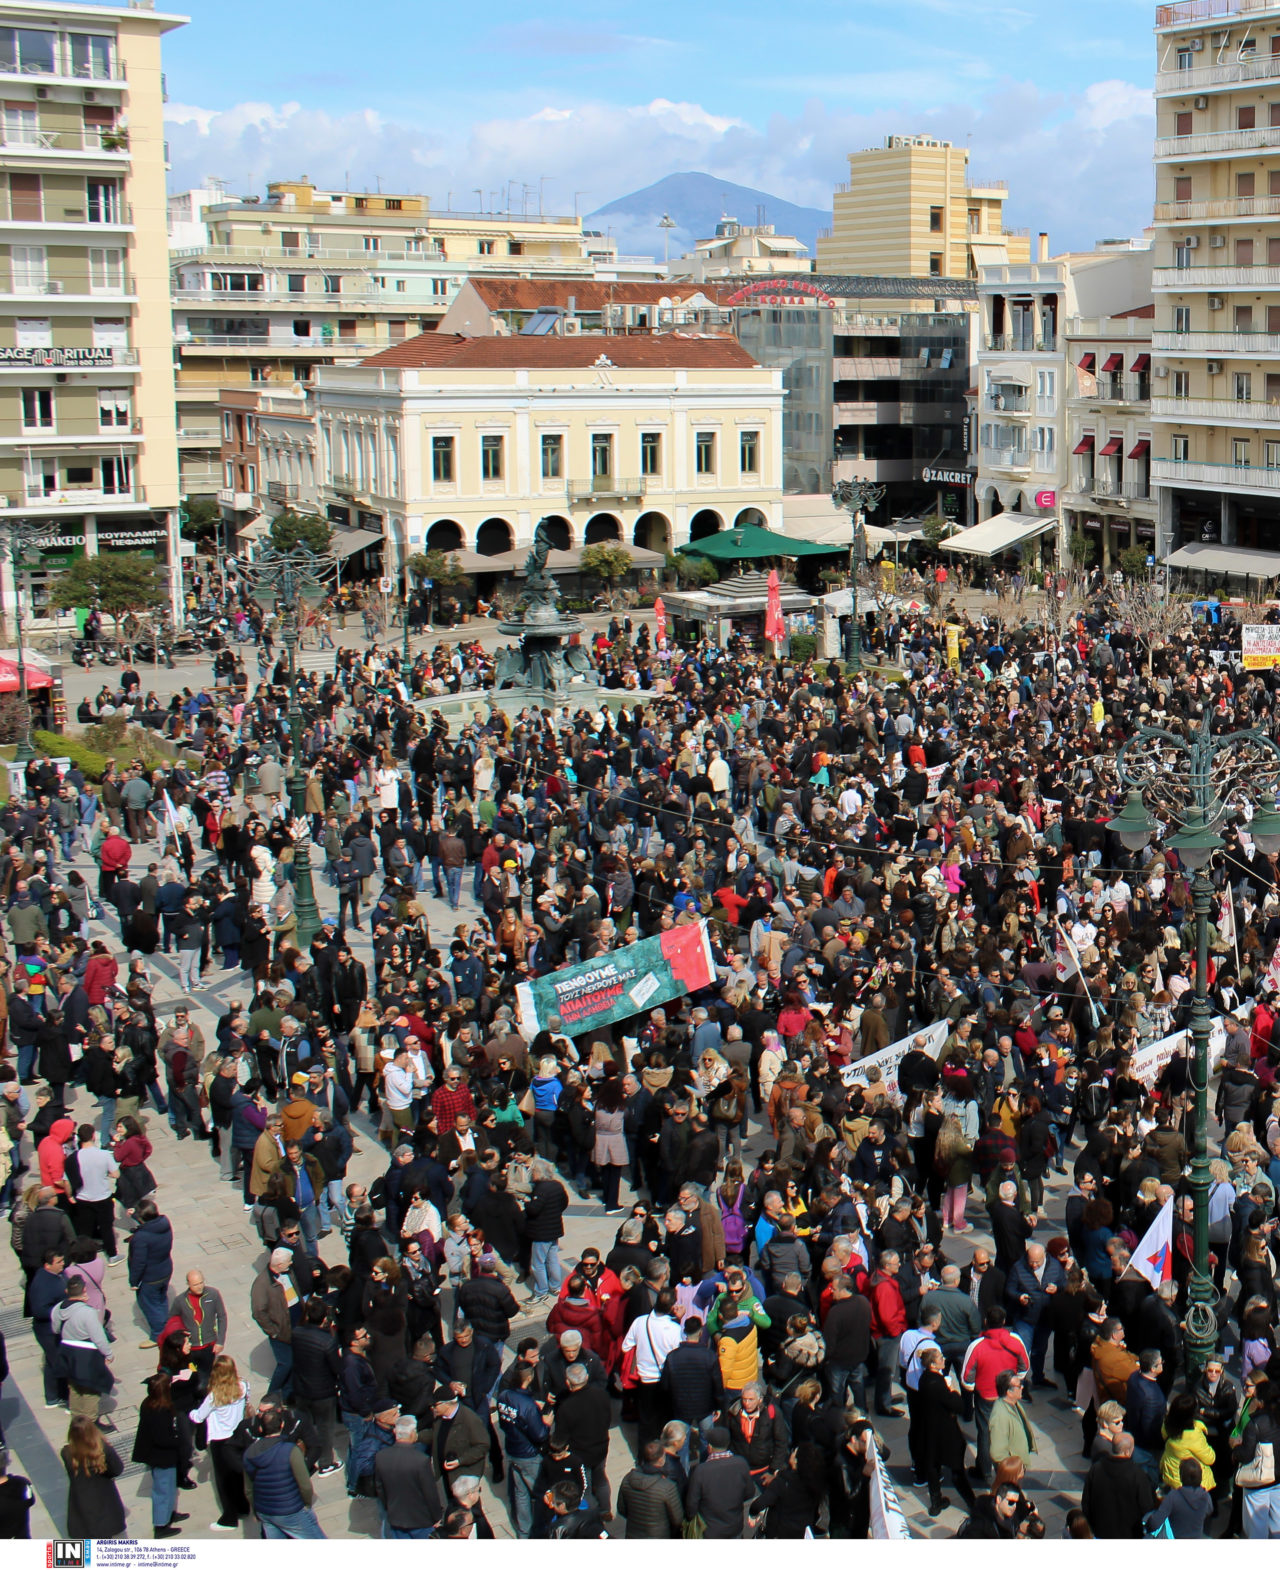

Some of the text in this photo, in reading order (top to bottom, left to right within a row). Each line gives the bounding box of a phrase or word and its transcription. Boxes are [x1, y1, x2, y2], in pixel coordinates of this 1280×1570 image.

[64, 348, 112, 359] RITUAL
[930, 470, 972, 484] ZAKCRET
[97, 530, 168, 540] ΚΟΥΡΛΑΜΠΑ
[110, 538, 157, 546] ΠΕΦΑΝΗ
[554, 963, 618, 994] ΠΕΝΘΟΥΜΕ
[560, 988, 580, 1003] ΤΟΥΣ
[580, 977, 618, 996] ΝΕΚΡΟΥΣ
[617, 968, 637, 982] ΜΑΣ
[560, 983, 624, 1017] ΑΠΑΙΤΟΥΜΕ
[563, 998, 616, 1024] ΤΗΝ ΑΛΗΘΕΙΑ
